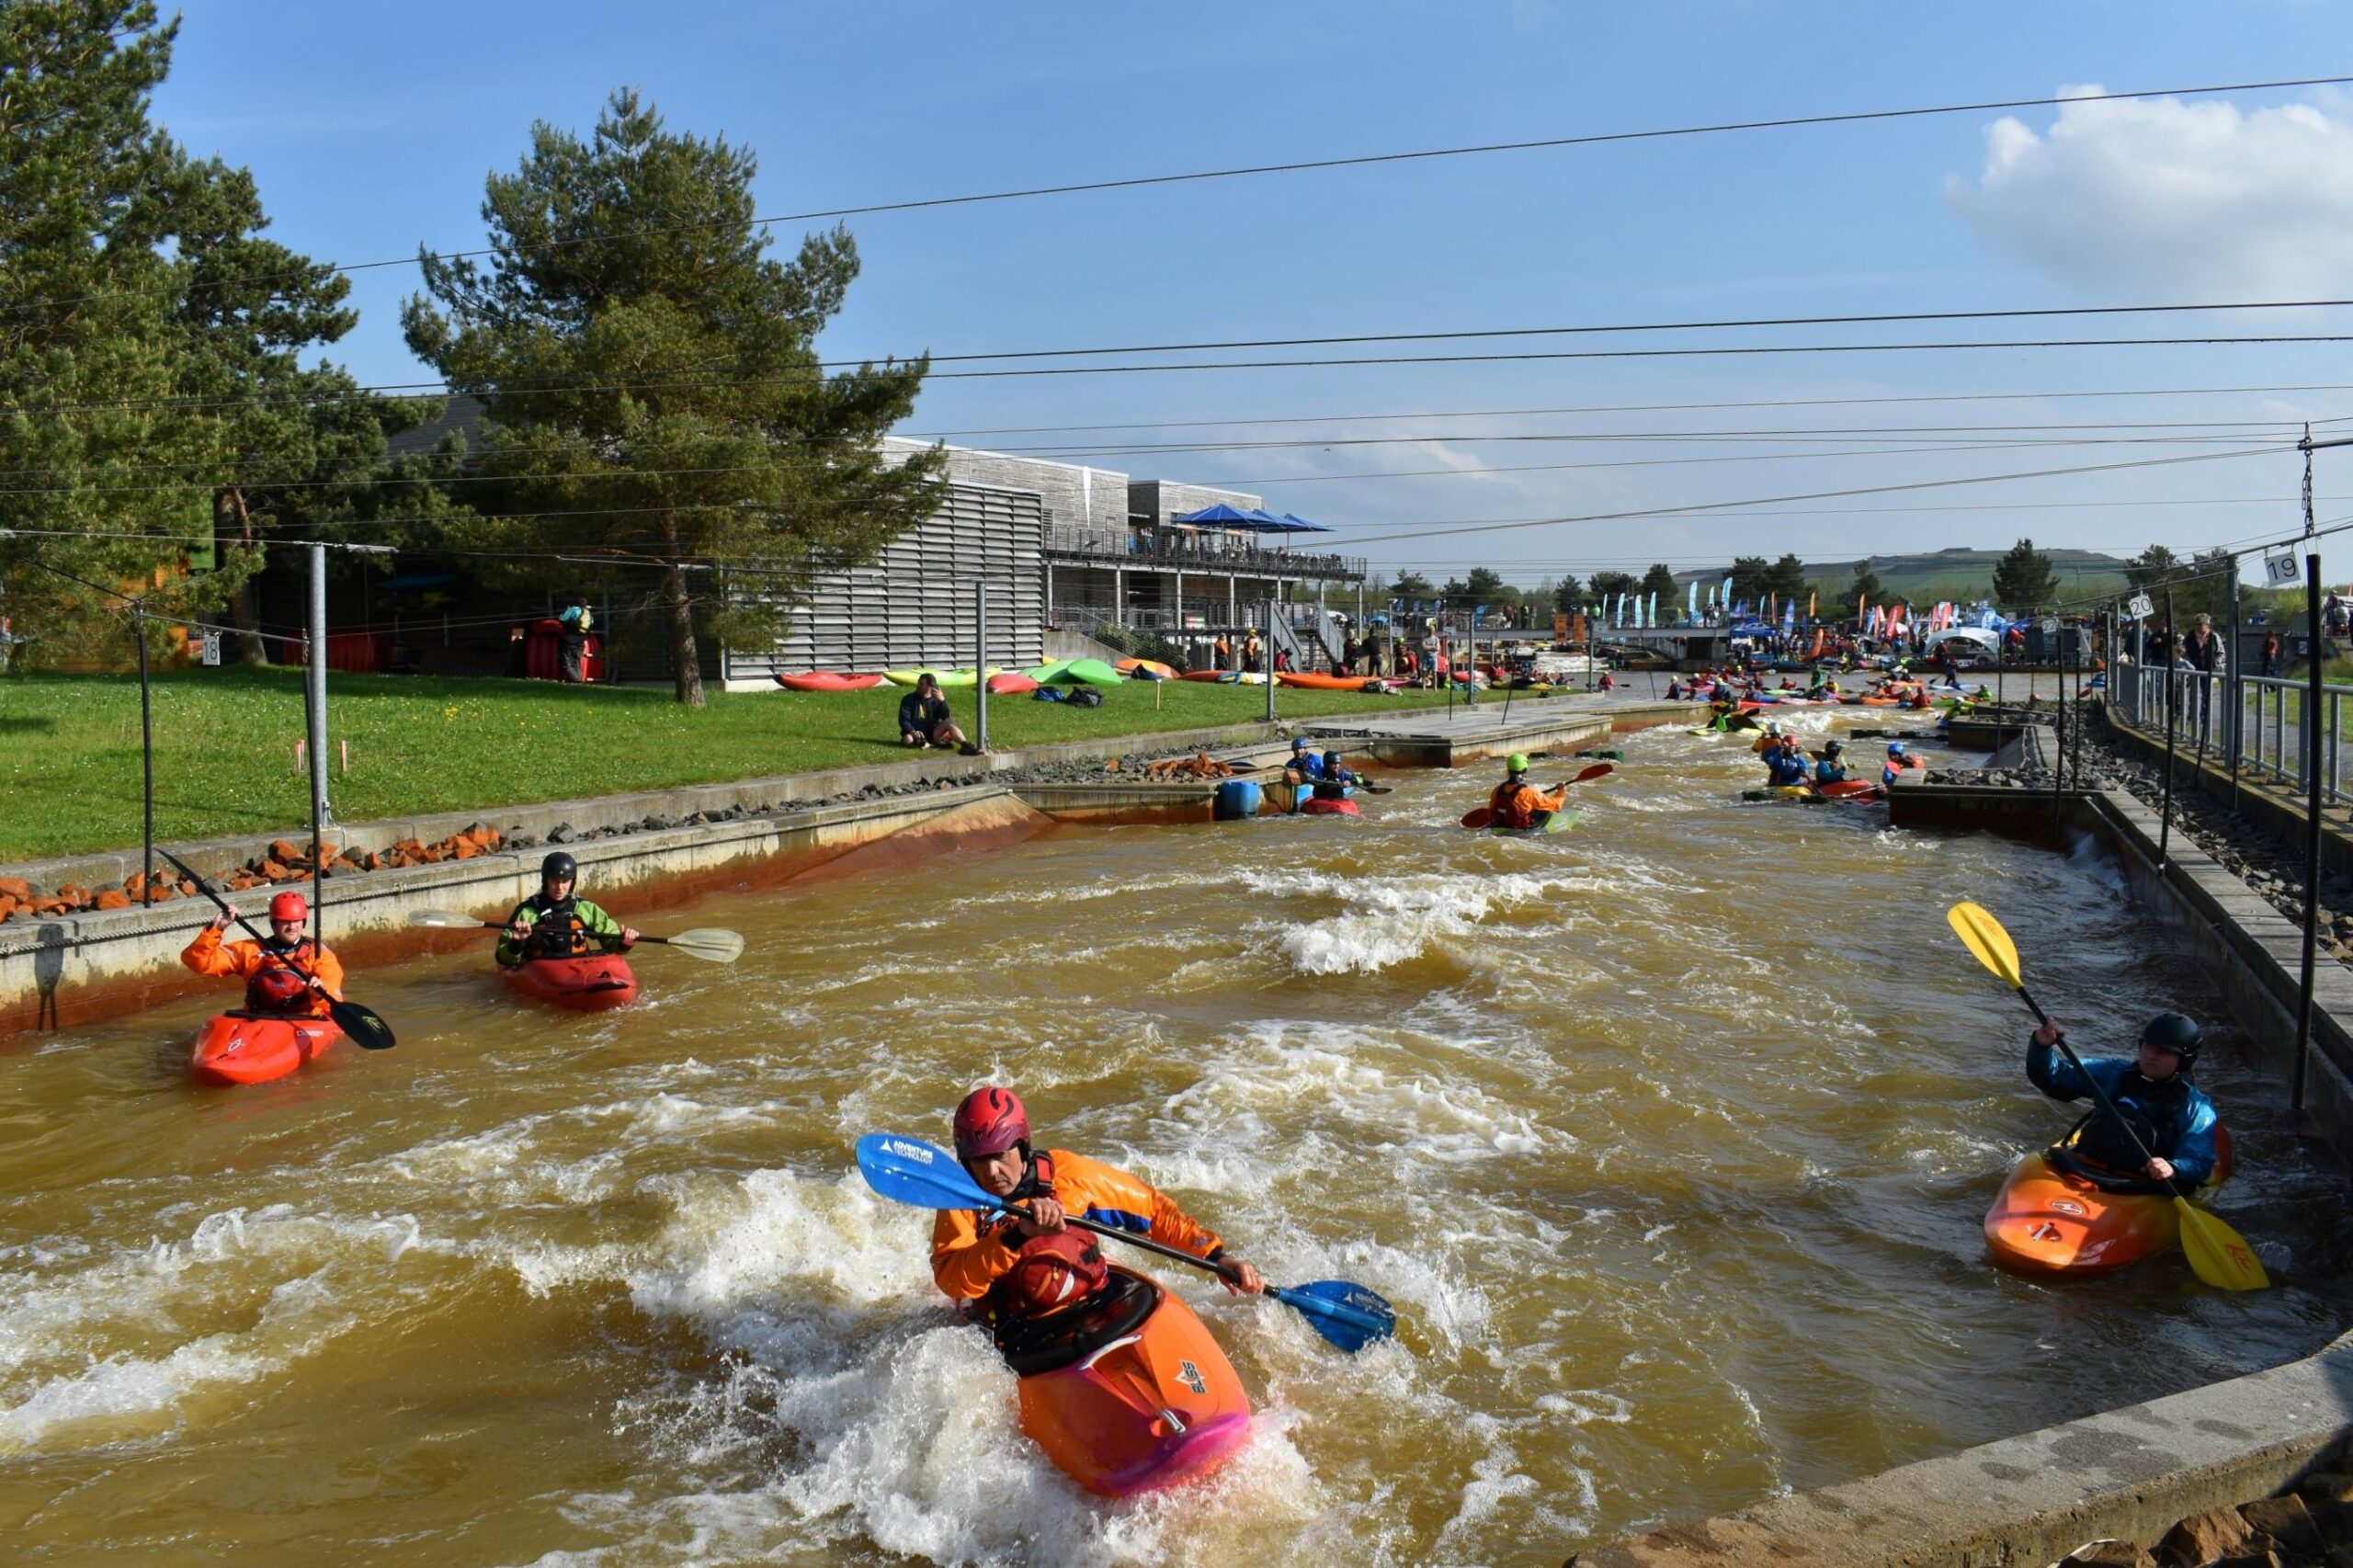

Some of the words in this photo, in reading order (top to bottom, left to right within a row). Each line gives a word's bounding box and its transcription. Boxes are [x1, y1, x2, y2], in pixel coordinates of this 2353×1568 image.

[2268, 558, 2296, 581] 19
[2131, 598, 2151, 616] 20
[204, 641, 217, 660] 18
